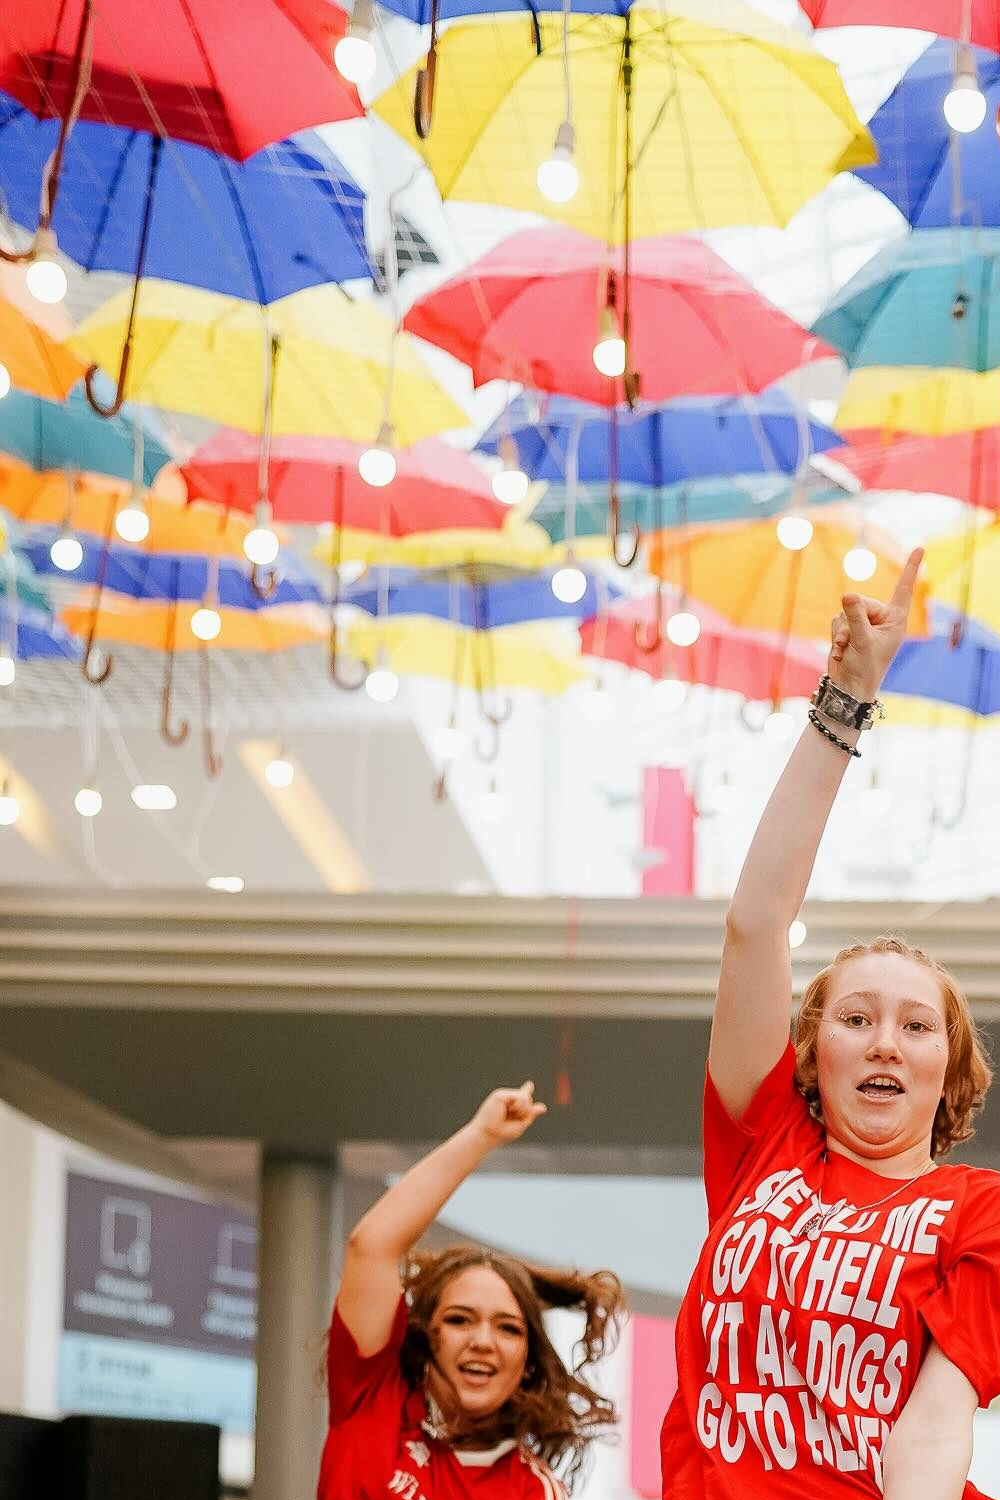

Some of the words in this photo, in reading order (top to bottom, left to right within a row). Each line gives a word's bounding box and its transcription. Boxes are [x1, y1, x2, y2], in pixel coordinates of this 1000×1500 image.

[879, 1197, 955, 1255] ME
[711, 1217, 769, 1297] GO
[766, 1226, 811, 1303] TO
[801, 1236, 906, 1330] HELL
[805, 1319, 908, 1415] DOGS
[735, 1392, 798, 1471] TO
